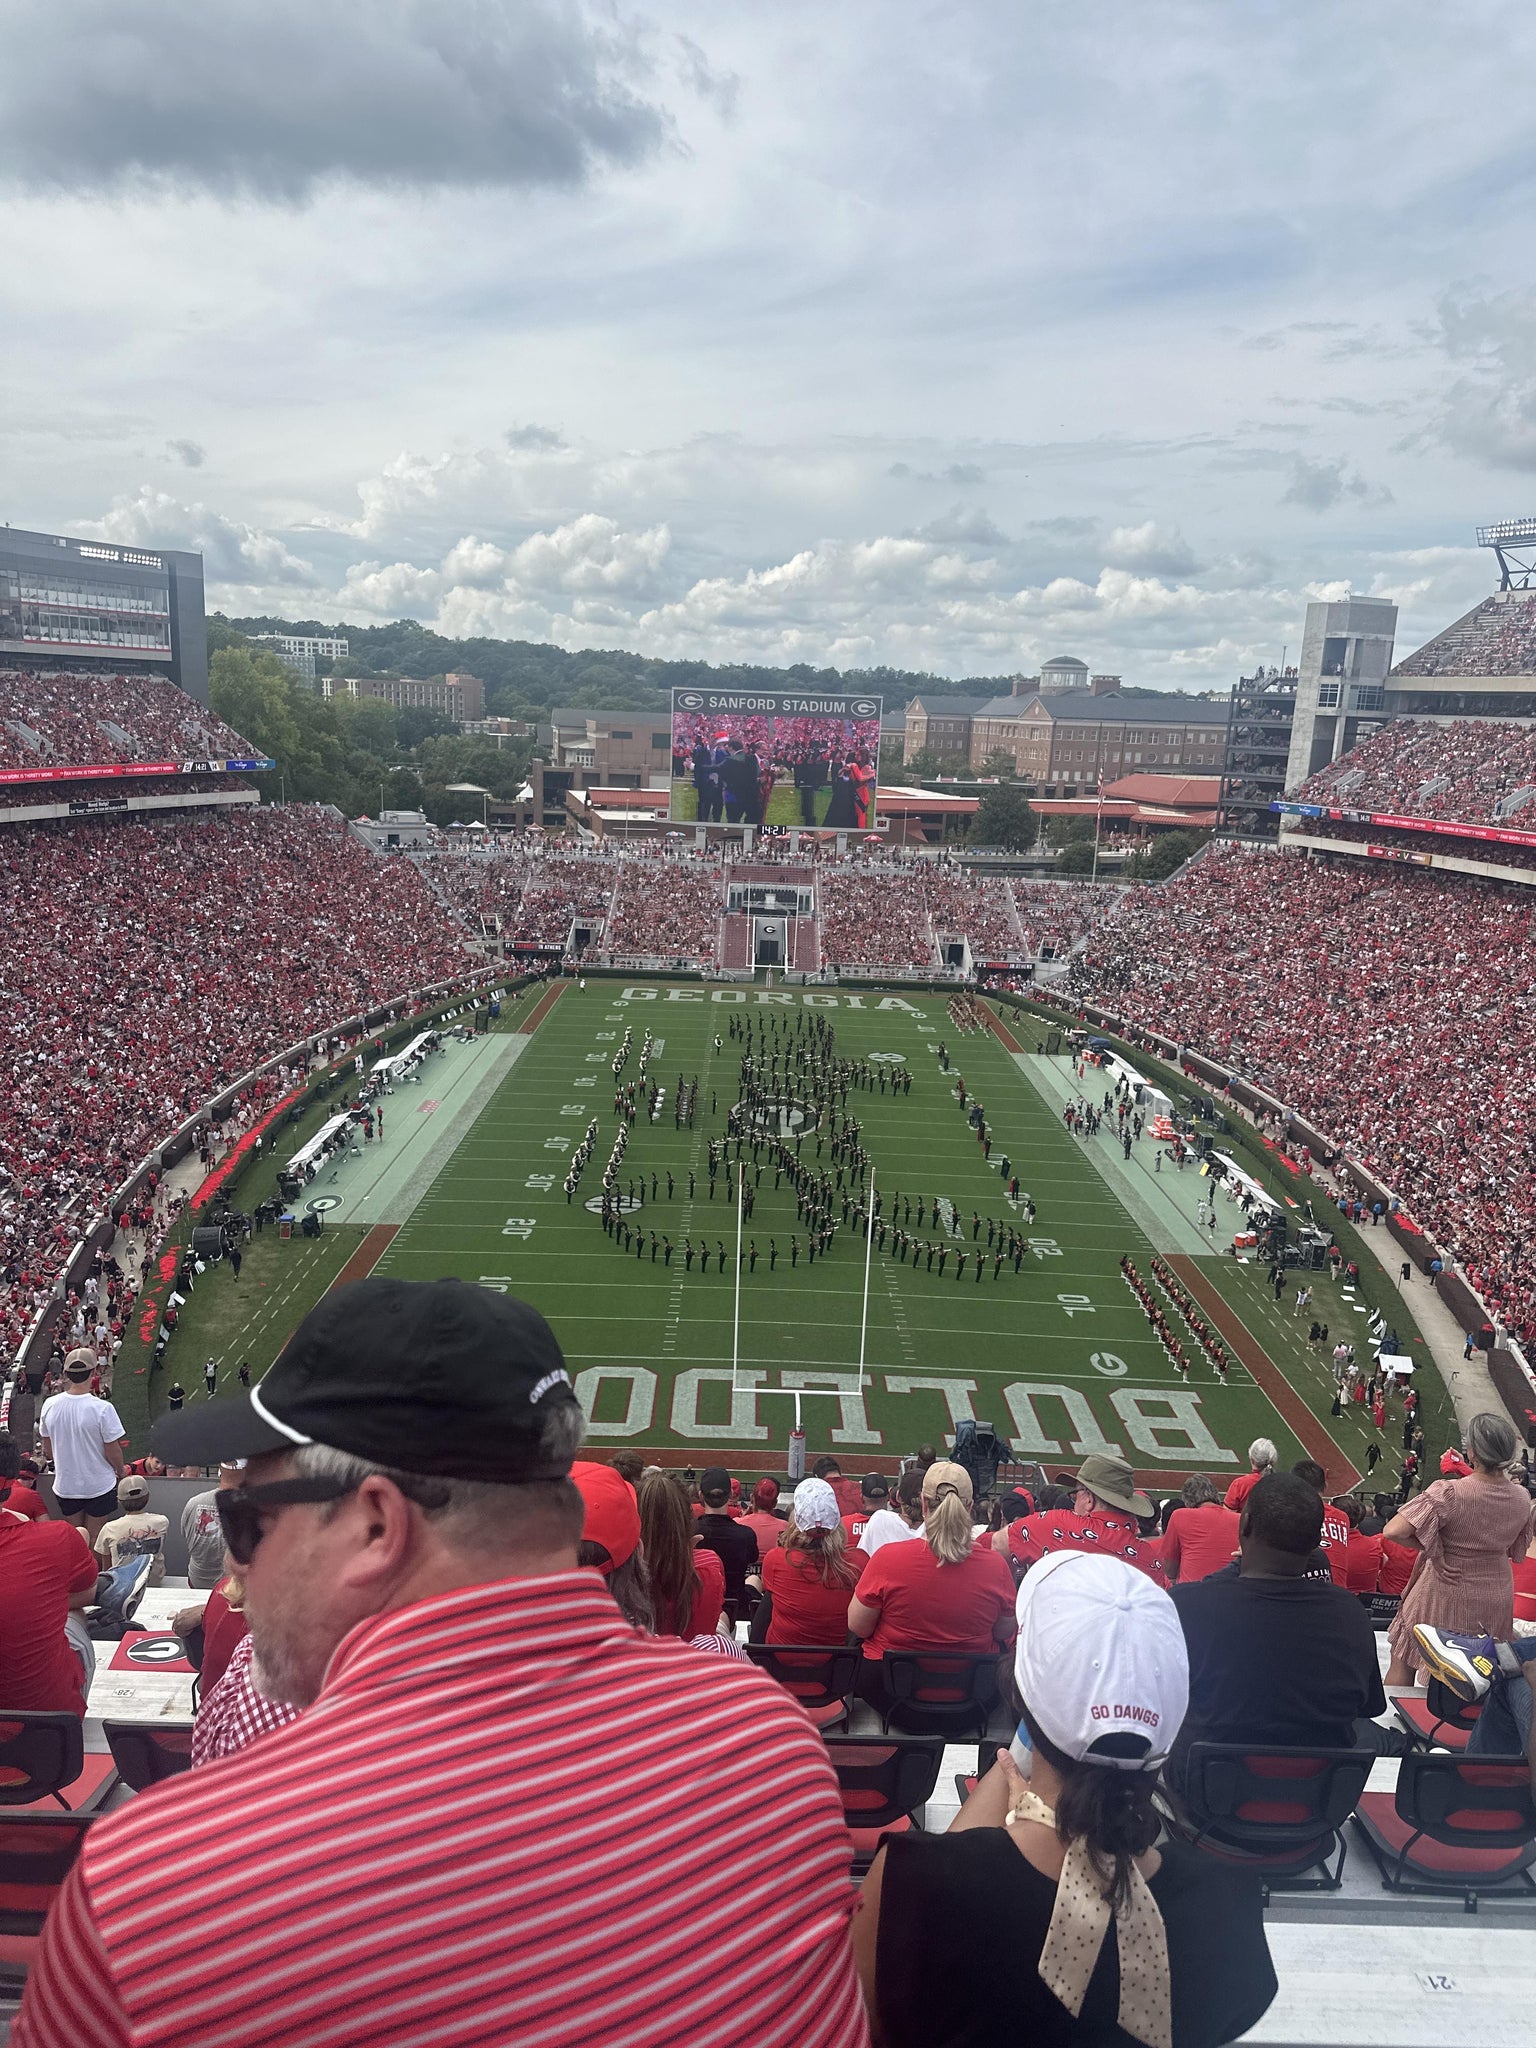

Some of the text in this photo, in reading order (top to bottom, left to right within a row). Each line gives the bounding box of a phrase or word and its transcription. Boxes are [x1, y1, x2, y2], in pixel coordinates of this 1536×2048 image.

[709, 696, 776, 711] SANFORD
[782, 700, 846, 713] STADIUM
[761, 826, 786, 835] 14:21
[620, 987, 920, 1012] GEORGIA
[560, 1104, 586, 1116] 50
[544, 1136, 572, 1150] 40
[524, 1174, 556, 1188] 30
[502, 1218, 537, 1236] 20
[1027, 1238, 1064, 1256] 20
[1056, 1293, 1096, 1313] 10
[1090, 1352, 1129, 1377] G
[1090, 1704, 1160, 1727] GO DAWGS
[1428, 1976, 1452, 1990] 21
